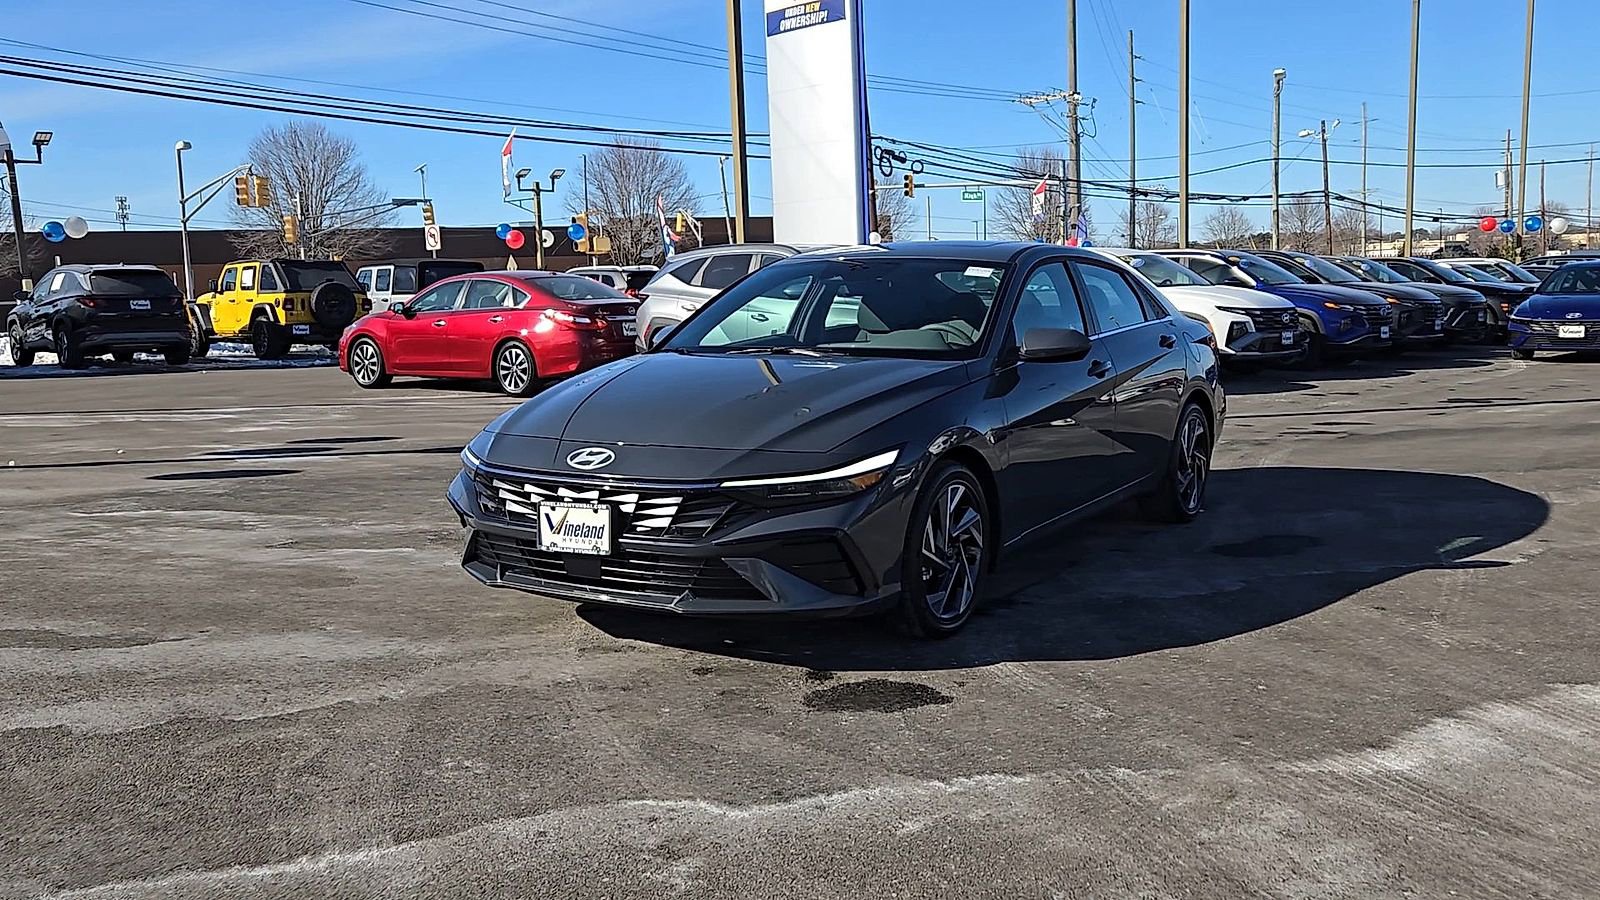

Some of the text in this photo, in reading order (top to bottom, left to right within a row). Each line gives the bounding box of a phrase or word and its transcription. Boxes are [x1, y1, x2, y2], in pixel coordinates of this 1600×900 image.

[785, 2, 821, 18] UNDER NEW
[779, 10, 828, 31] OWNERSHIP!
[544, 508, 605, 539] Vineland
[563, 538, 603, 546] HYUNDAI
